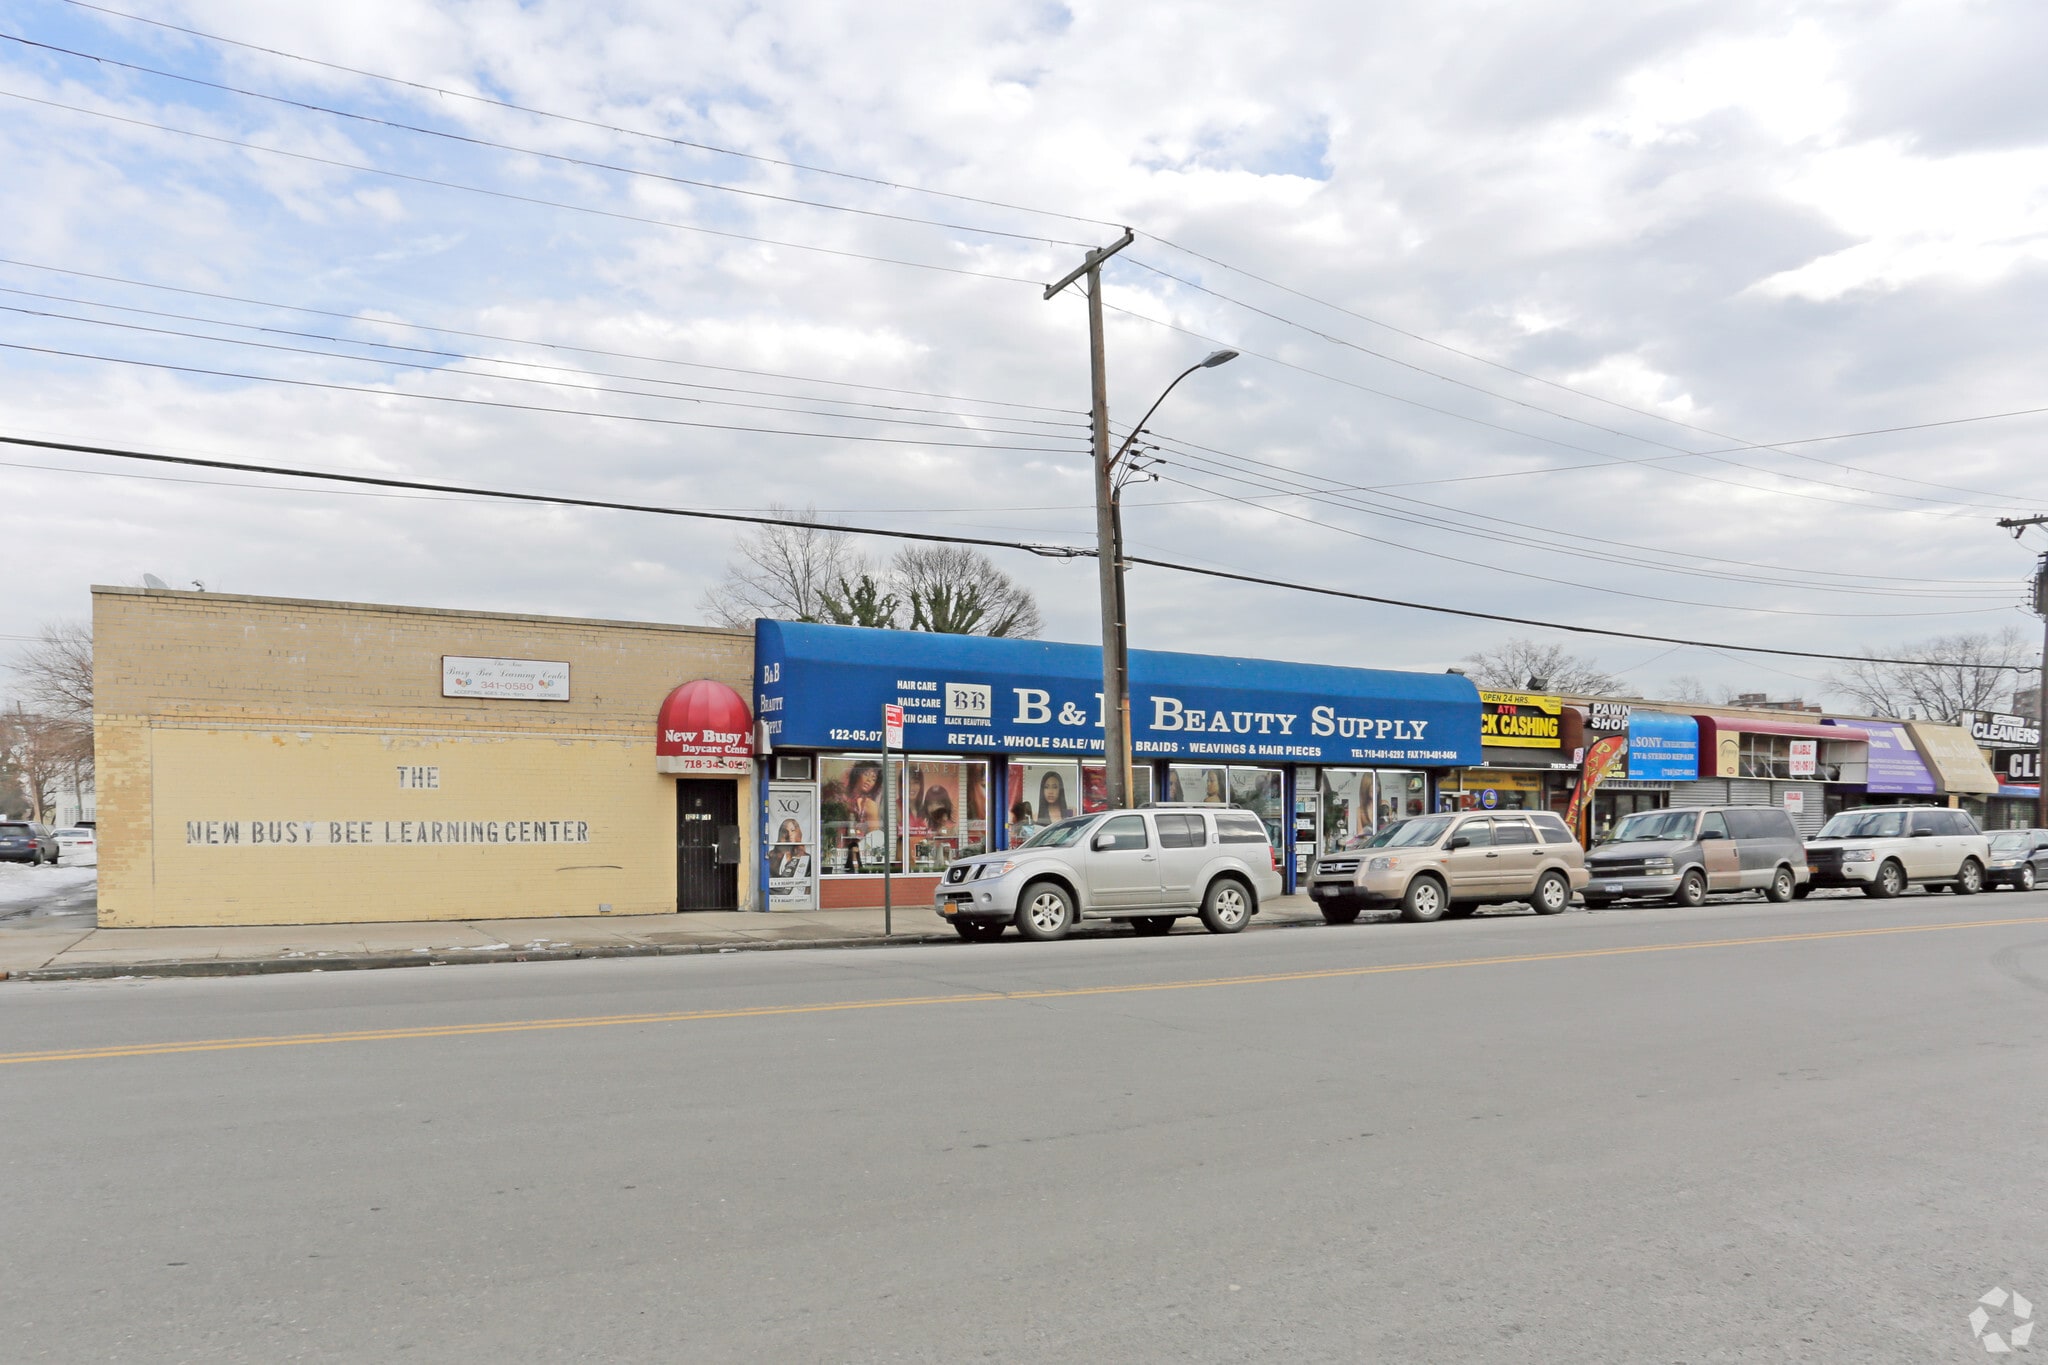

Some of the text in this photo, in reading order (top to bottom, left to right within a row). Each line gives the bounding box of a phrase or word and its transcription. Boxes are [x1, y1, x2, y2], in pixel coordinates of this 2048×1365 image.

[481, 681, 534, 691] 341-0580
[897, 680, 937, 692] HAIR CARE
[760, 694, 784, 713] BEAUTY
[897, 697, 941, 708] NAILS CARE
[1483, 693, 1502, 702] OPEN
[1503, 695, 1513, 703] 24
[1593, 703, 1631, 716] PAWN
[903, 714, 916, 724] KIN
[917, 714, 937, 725] CARE
[944, 716, 992, 727] BLACK BEAUTIFUL
[1150, 695, 1298, 735] BEAUTY
[1311, 705, 1429, 740] SUPPLY
[1591, 717, 1629, 730] SHOP
[1501, 714, 1559, 737] CASHING
[665, 729, 698, 743] New
[702, 729, 742, 747] Busy
[1972, 722, 2040, 744] CLEANERS
[1004, 735, 1050, 748] WHOLE
[1135, 741, 1178, 753] BRAIDS
[1189, 742, 1246, 755] WEAVINGS
[1248, 744, 1256, 755] &
[1258, 744, 1283, 756] HAIR
[1285, 746, 1321, 757] PIECES
[1635, 736, 1663, 748] SONY
[682, 743, 722, 755] Daycare
[1351, 749, 1363, 758] TEL
[1407, 750, 1419, 759] FAX
[1633, 752, 1642, 760] TV
[1648, 752, 1671, 760] STEREO
[397, 766, 438, 788] THE
[778, 799, 800, 814] XQ
[186, 820, 589, 844] NEW BUSY BEE LEARNING CENTER
